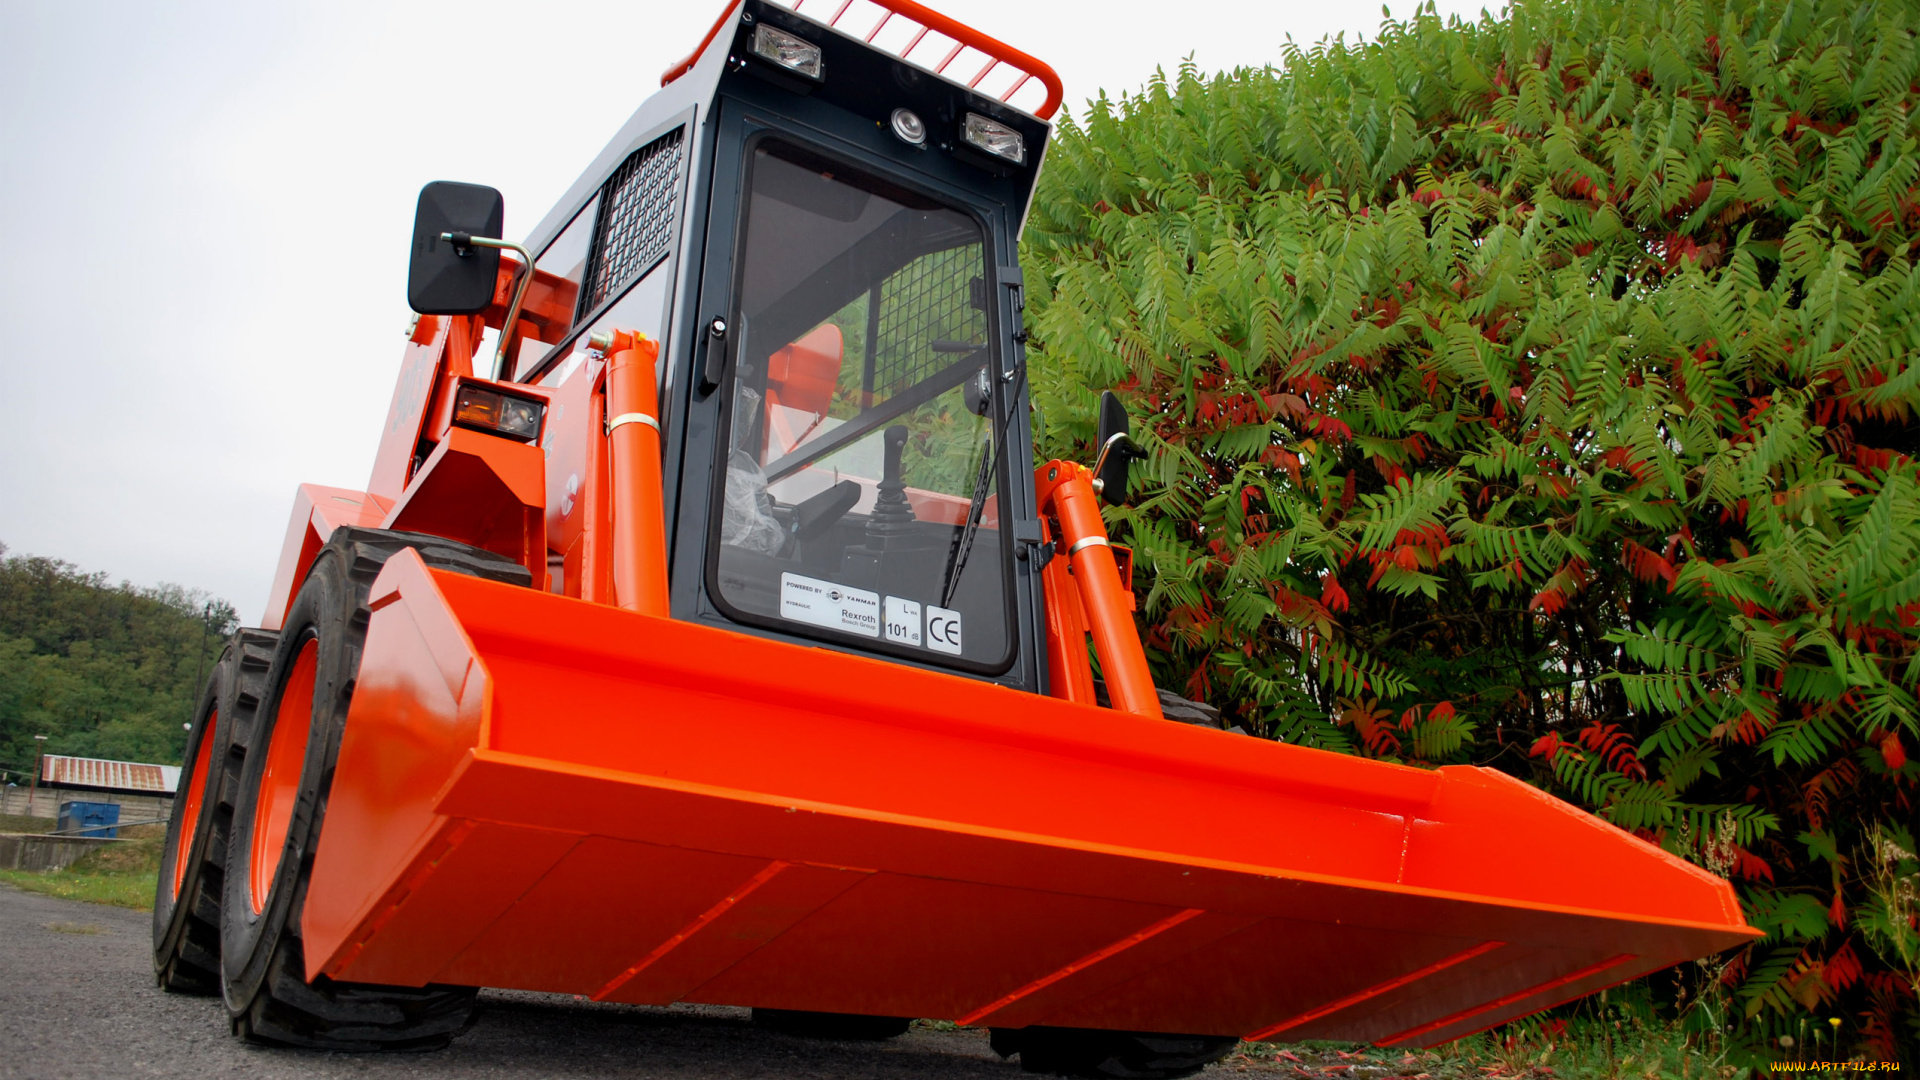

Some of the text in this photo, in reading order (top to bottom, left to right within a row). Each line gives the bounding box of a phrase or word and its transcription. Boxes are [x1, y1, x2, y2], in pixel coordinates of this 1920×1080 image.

[786, 581, 813, 592] POWERED
[846, 596, 876, 606] YANMAR
[786, 600, 811, 609] HYDRAULIC
[903, 604, 908, 614] L
[841, 609, 876, 624] Rexroth
[842, 618, 876, 630] Bosch Group
[887, 622, 907, 638] 101
[929, 616, 959, 646] CE
